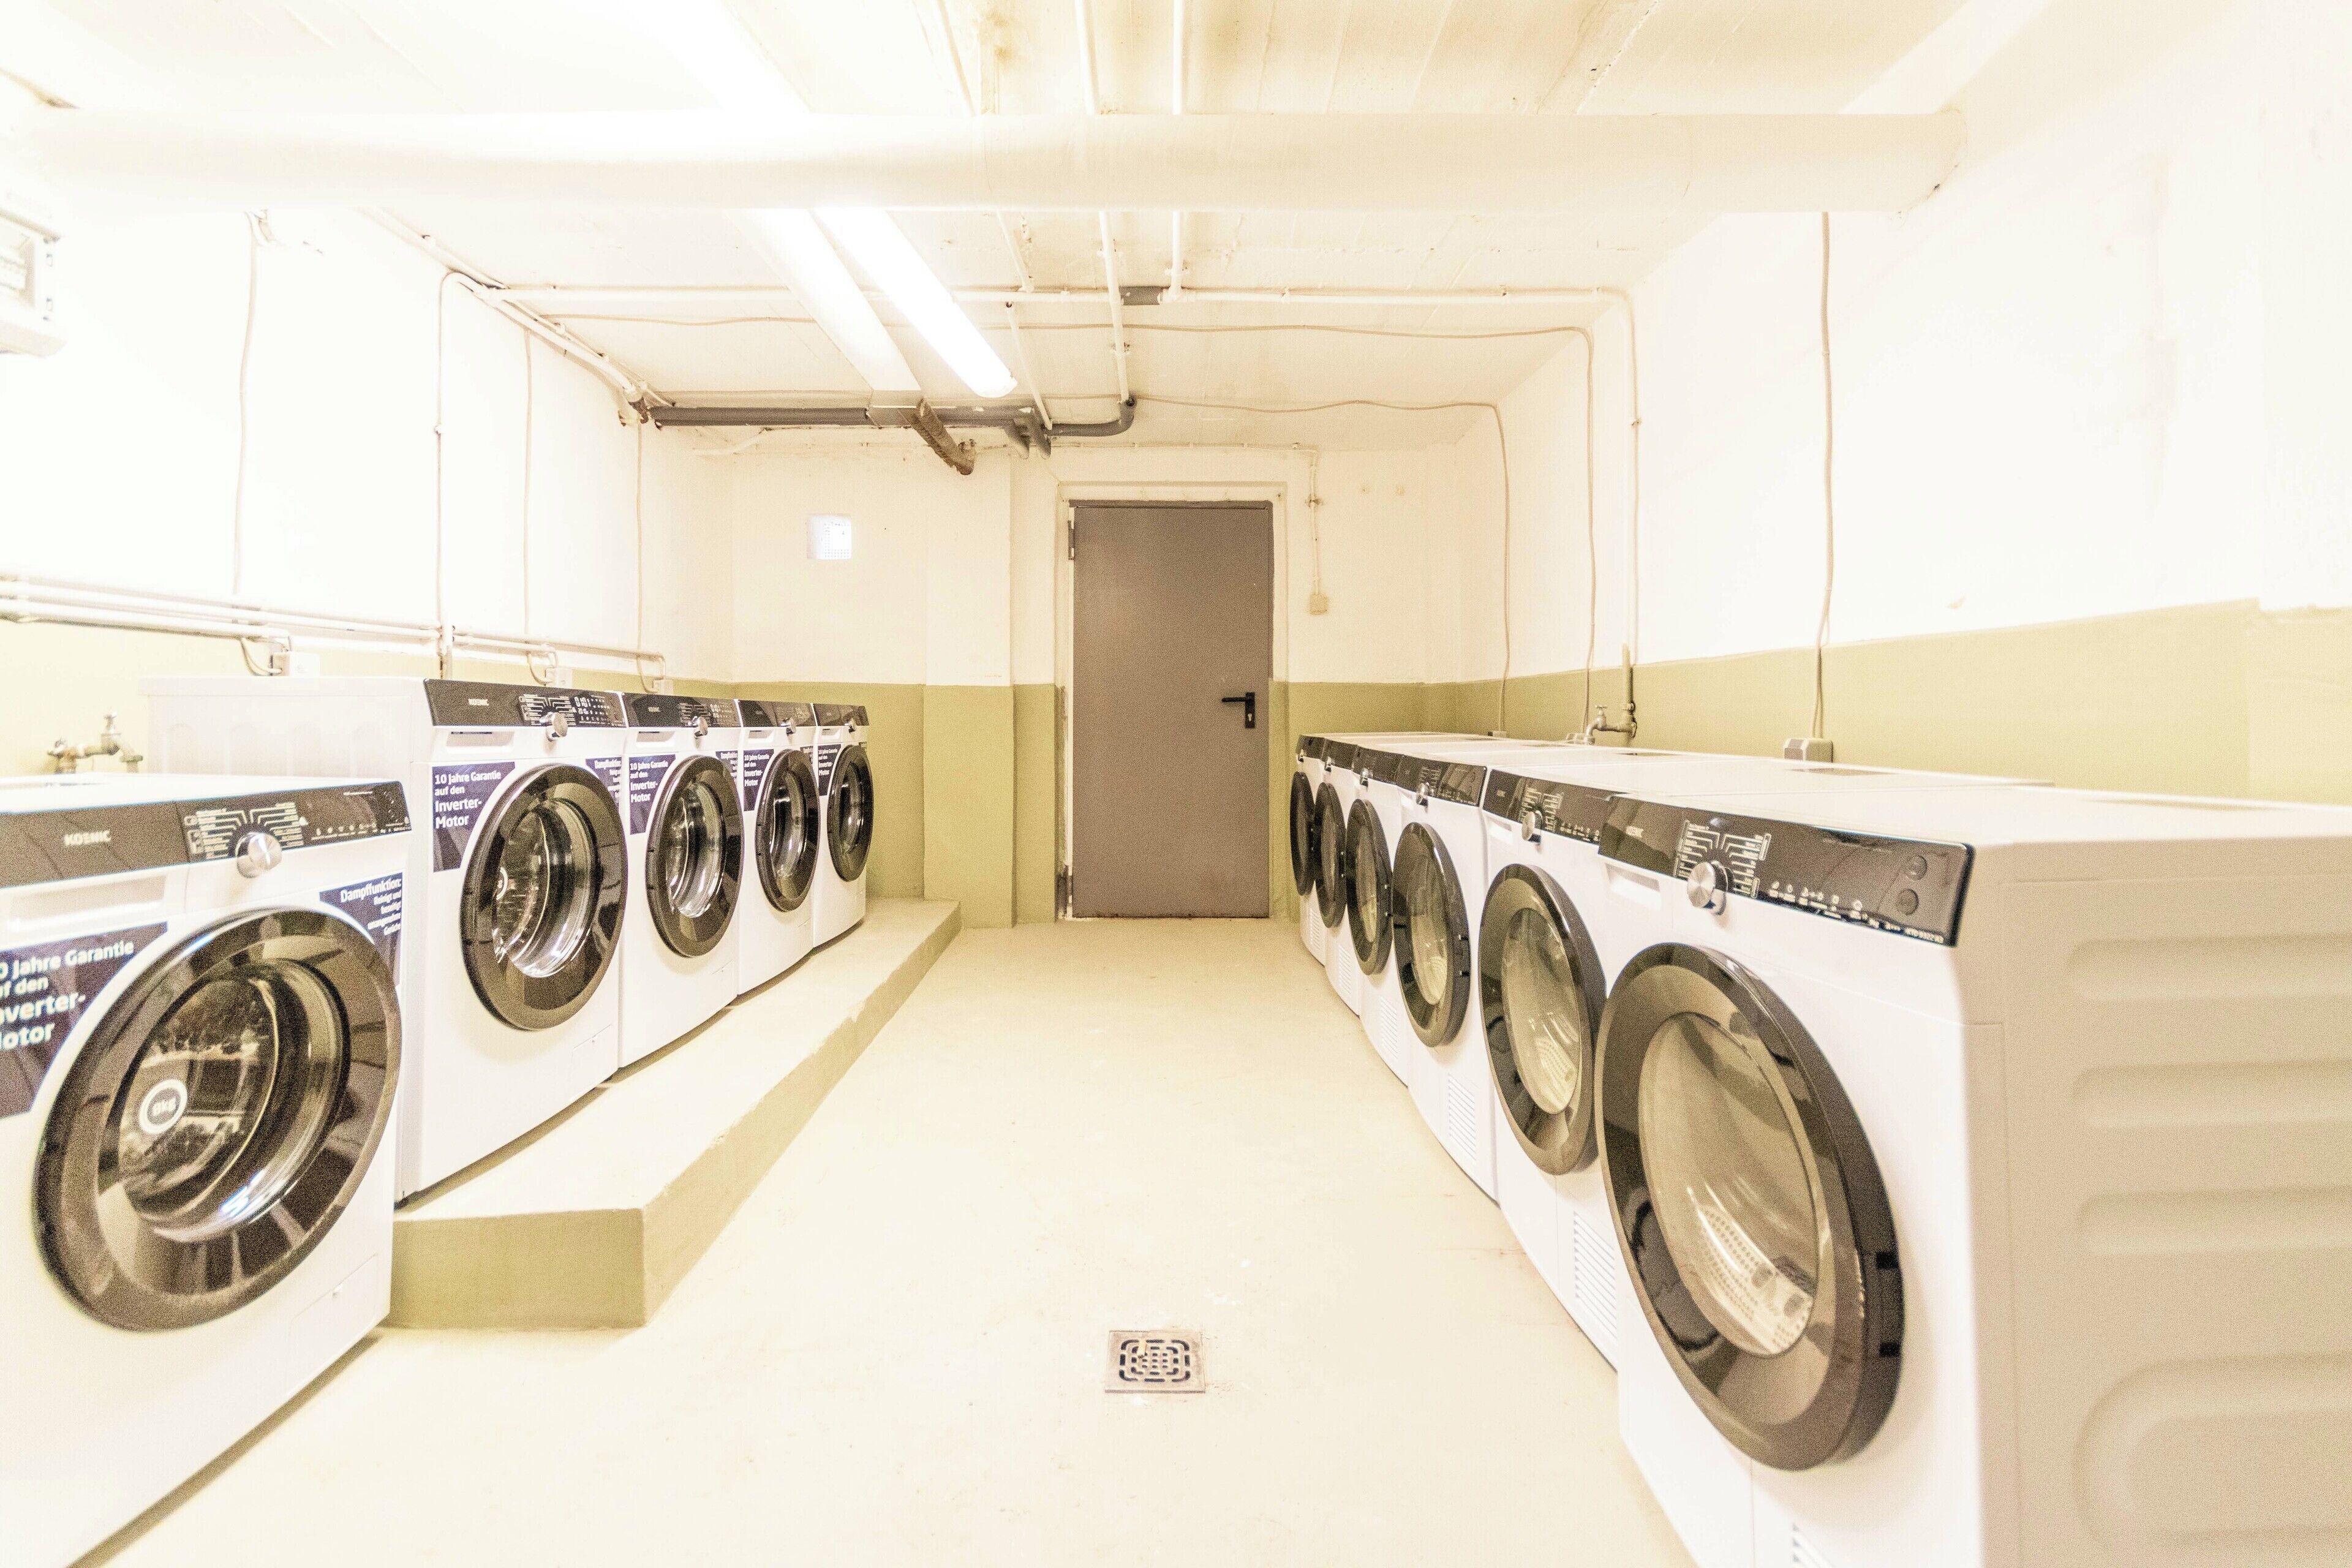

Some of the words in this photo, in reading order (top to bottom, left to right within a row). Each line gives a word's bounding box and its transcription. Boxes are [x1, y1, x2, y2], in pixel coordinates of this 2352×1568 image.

[638, 762, 650, 771] Jahre
[434, 774, 448, 785] 10
[448, 772, 470, 785] Jahre
[470, 770, 502, 782] Garantie
[434, 786, 449, 796] auf
[450, 786, 465, 795] den
[630, 781, 658, 791] Inverter-
[435, 798, 483, 813] Inverter-
[631, 793, 651, 803] Motor
[435, 815, 470, 829] Motor
[340, 878, 402, 903] Dampffunktion:
[12, 956, 62, 980] Jahre
[64, 940, 135, 967] Garantie
[15, 976, 49, 995] den
[0, 991, 86, 1025] verter-
[0, 1022, 55, 1050] otor
